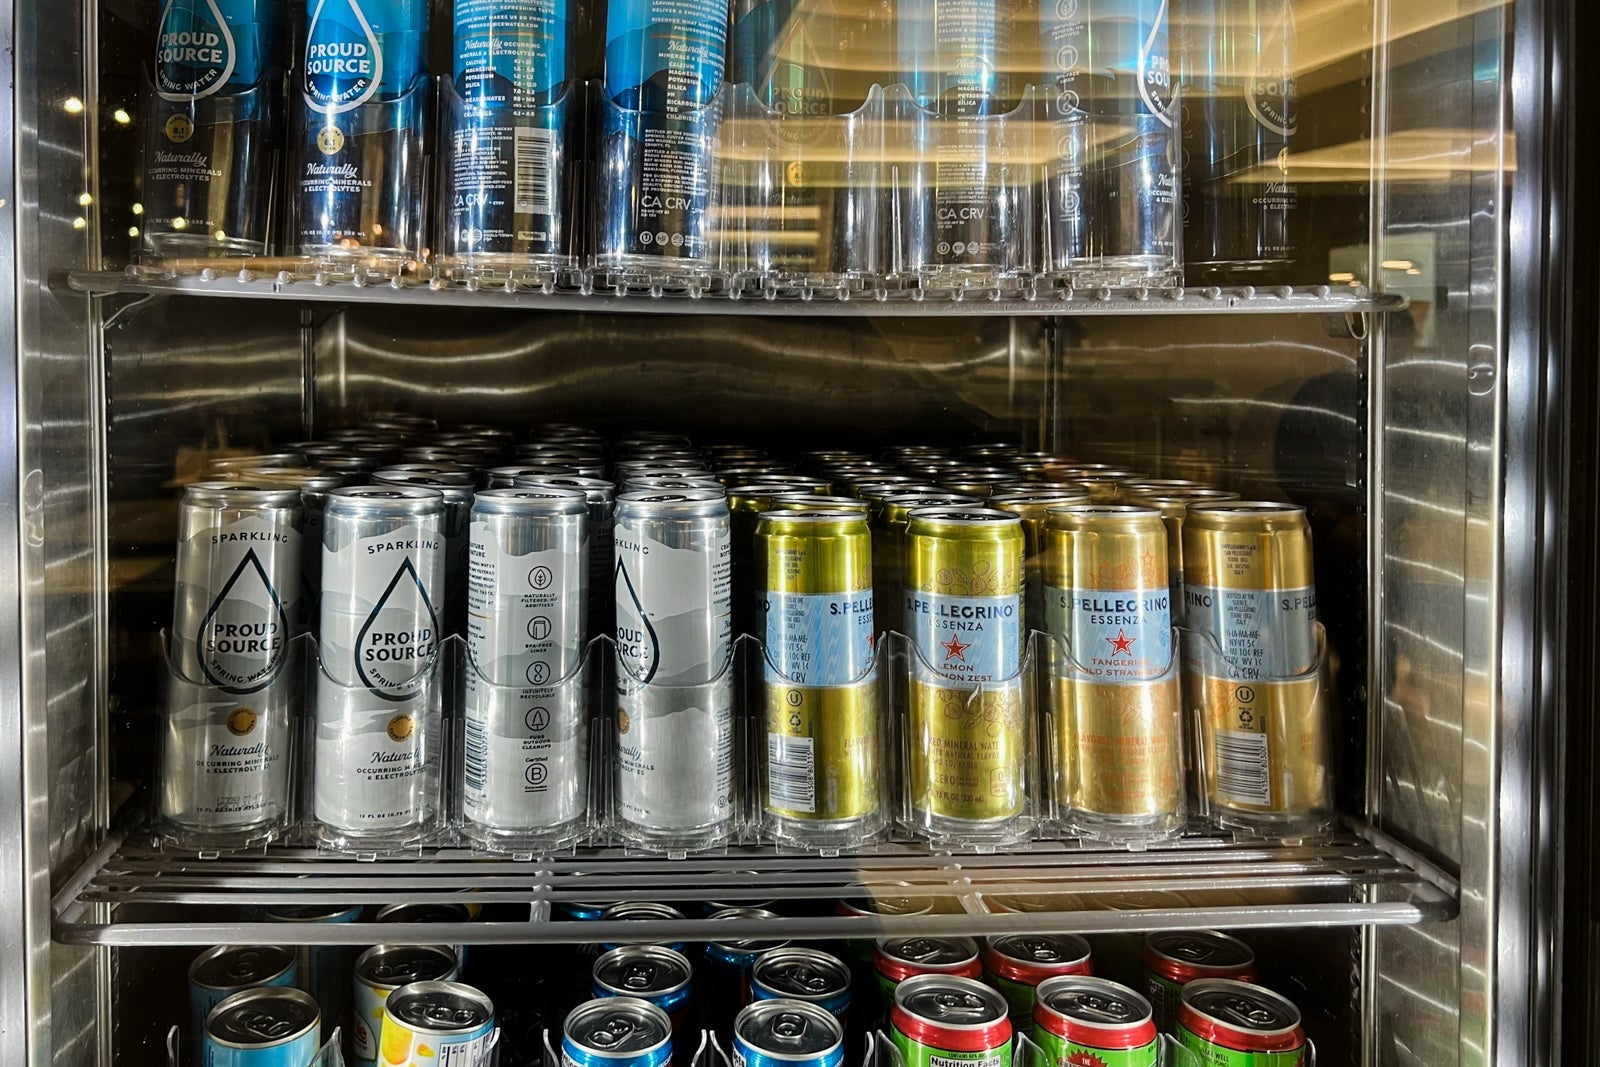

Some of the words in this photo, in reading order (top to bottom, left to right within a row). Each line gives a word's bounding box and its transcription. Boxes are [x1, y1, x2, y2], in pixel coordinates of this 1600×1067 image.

[162, 32, 219, 47] PROUD
[464, 38, 502, 50] Naturally
[310, 42, 367, 58] PROUD
[460, 51, 482, 59] MINERALS
[668, 40, 709, 58] Naturally
[158, 48, 223, 64] SOURCE
[658, 52, 690, 61] MINERALS
[307, 58, 370, 75] SOURCE
[465, 66, 497, 74] MAGNESIUM
[159, 69, 182, 92] SPRING
[185, 68, 218, 90] WATER
[465, 73, 494, 81] POTASSIUM
[308, 80, 331, 102] SPRING
[335, 78, 366, 102] WATER
[773, 87, 824, 101] PROUD
[775, 101, 828, 115] OURCE
[1150, 91, 1166, 114] SPRI
[666, 114, 699, 123] CHLORIDES
[1260, 101, 1288, 124] SPRING
[154, 150, 208, 168] Naturally
[180, 168, 222, 176] MINERALS
[306, 162, 358, 178] Naturally
[332, 178, 372, 186] MINERALS
[454, 194, 464, 206] CA
[466, 194, 488, 206] CRV
[641, 196, 662, 208] CA
[665, 197, 691, 211] CRV
[938, 208, 957, 219] CA
[960, 208, 985, 219] CRV
[212, 532, 288, 544] SPARKLING
[368, 540, 439, 554] SPARKLING
[907, 598, 1014, 620] S.PELEGRINO
[1060, 596, 1168, 612] S.PELLEGRINO
[927, 618, 984, 631] ESSENZA
[1090, 615, 1148, 625] ESSENZA
[214, 622, 278, 637] PROUD
[372, 629, 432, 646] PROUD
[206, 636, 280, 653] SOURCE
[366, 642, 438, 662] SOURCE
[801, 652, 811, 661] REF
[211, 659, 244, 683] SPRING
[247, 656, 278, 682] WATER
[938, 663, 974, 672] LEMON
[1228, 666, 1240, 678] CA
[1242, 667, 1259, 680] CRV
[791, 671, 806, 684] CRV
[210, 742, 270, 758] Naturally
[944, 740, 978, 751] MINERAL
[980, 741, 1000, 750] WATE
[945, 750, 974, 760] NATURAL
[356, 766, 402, 774] OCCURRING
[958, 760, 978, 769] ADDED
[934, 773, 955, 786] ZERO
[931, 1057, 975, 1067] Nutrition
[978, 1059, 1000, 1067] Facts
[1082, 1058, 1091, 1066] THE
[1215, 1053, 1229, 1062] WELL
